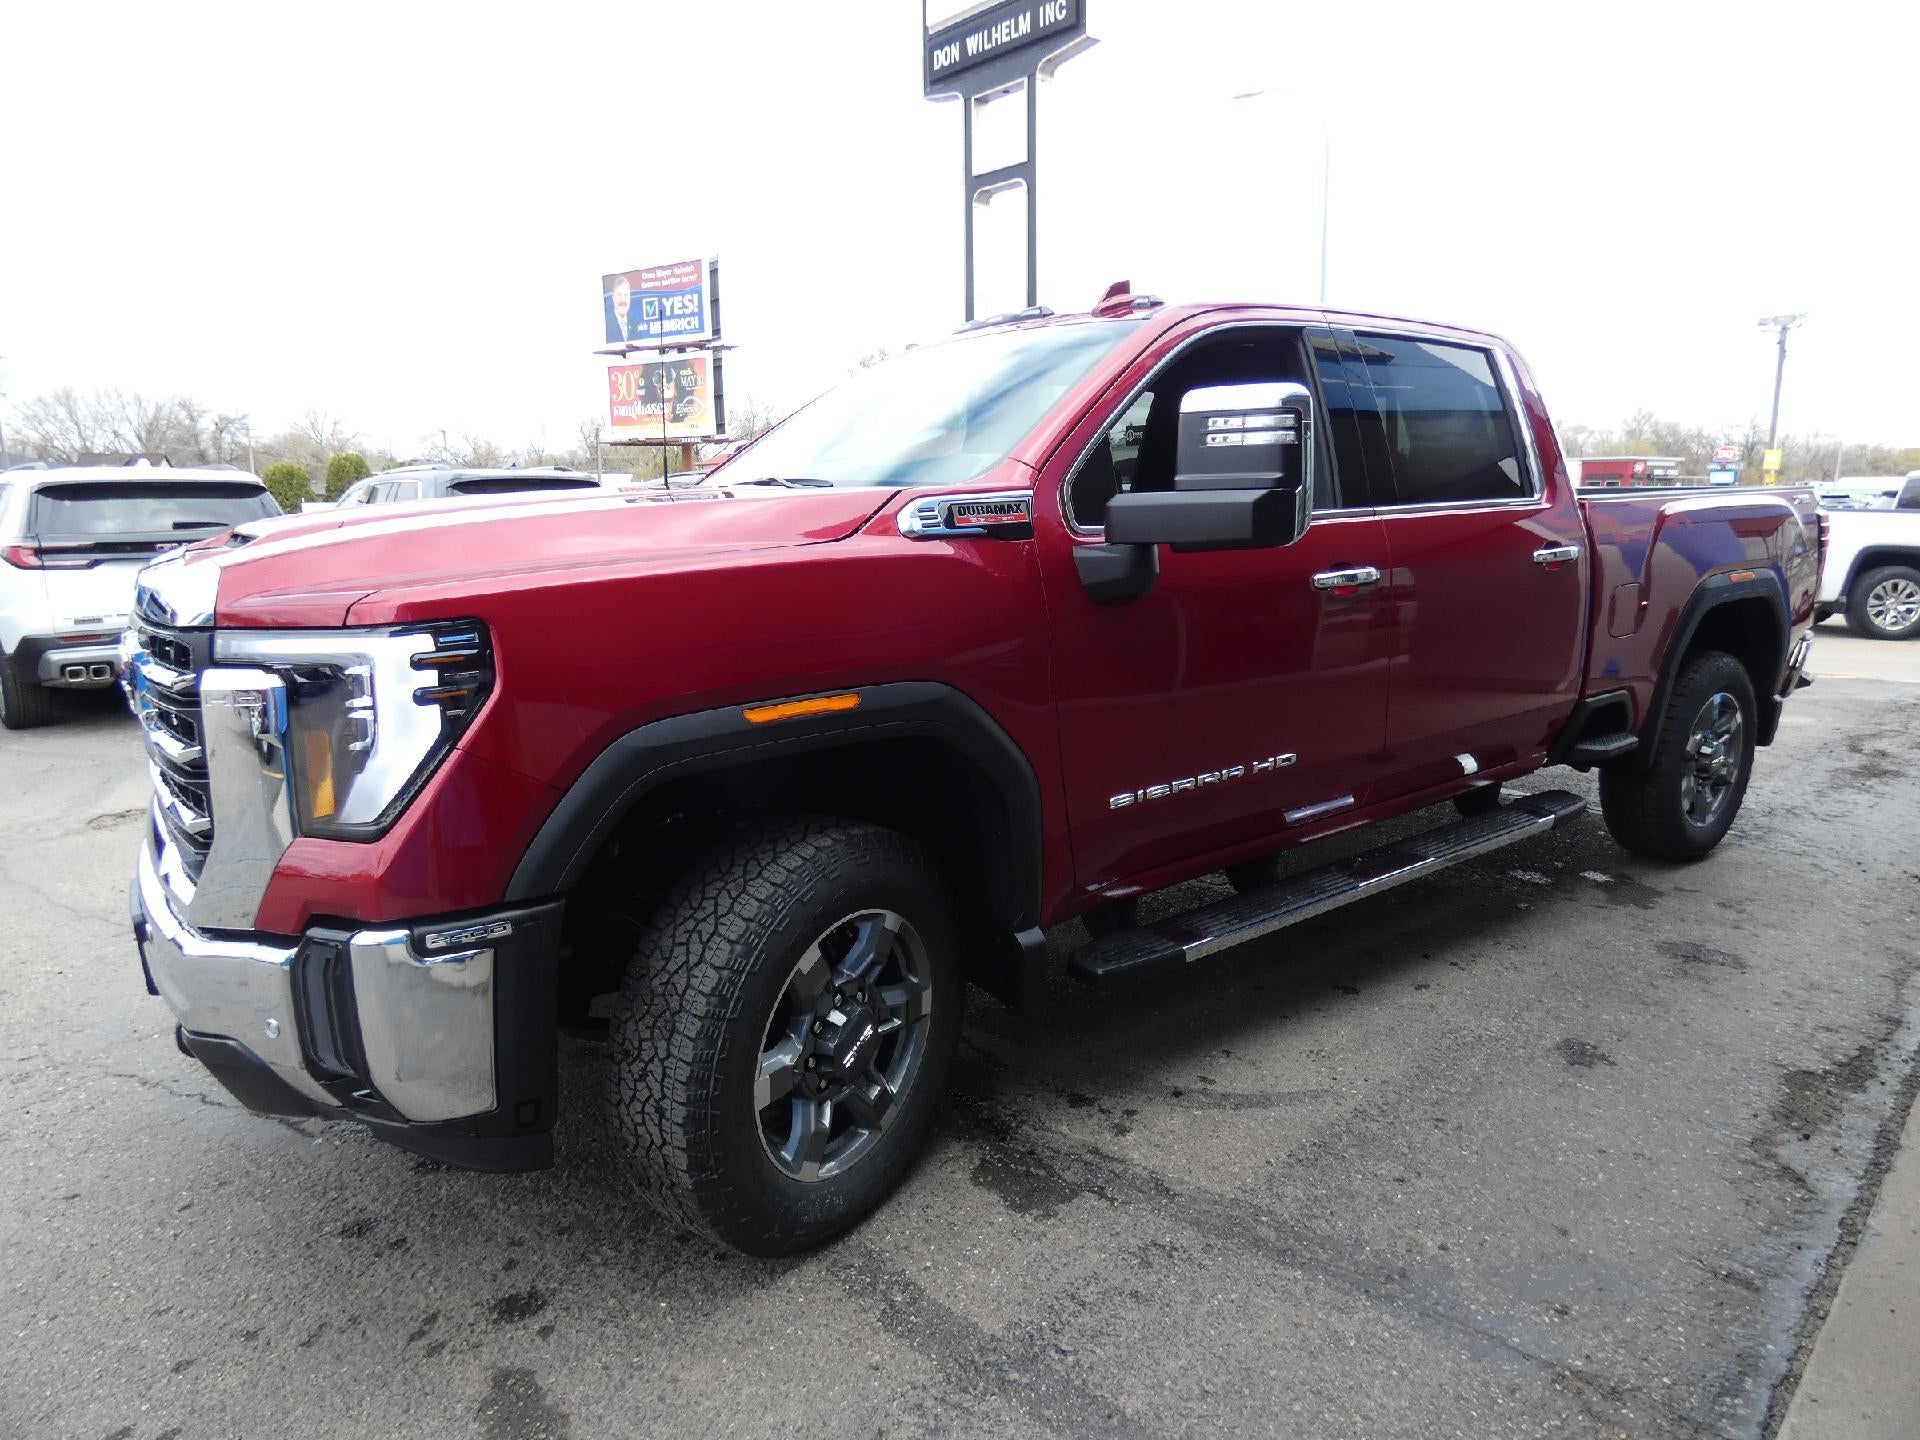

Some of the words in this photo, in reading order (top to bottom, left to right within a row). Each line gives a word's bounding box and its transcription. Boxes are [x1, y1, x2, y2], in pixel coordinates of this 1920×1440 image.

[933, 41, 960, 71] DON
[965, 11, 1031, 57] WILHELM
[1040, 0, 1067, 28] INC
[662, 293, 699, 316] YES!
[681, 375, 696, 387] MAY
[957, 503, 1024, 517] DURAMAX
[1109, 765, 1246, 810] SIERRA
[1252, 752, 1297, 774] HD
